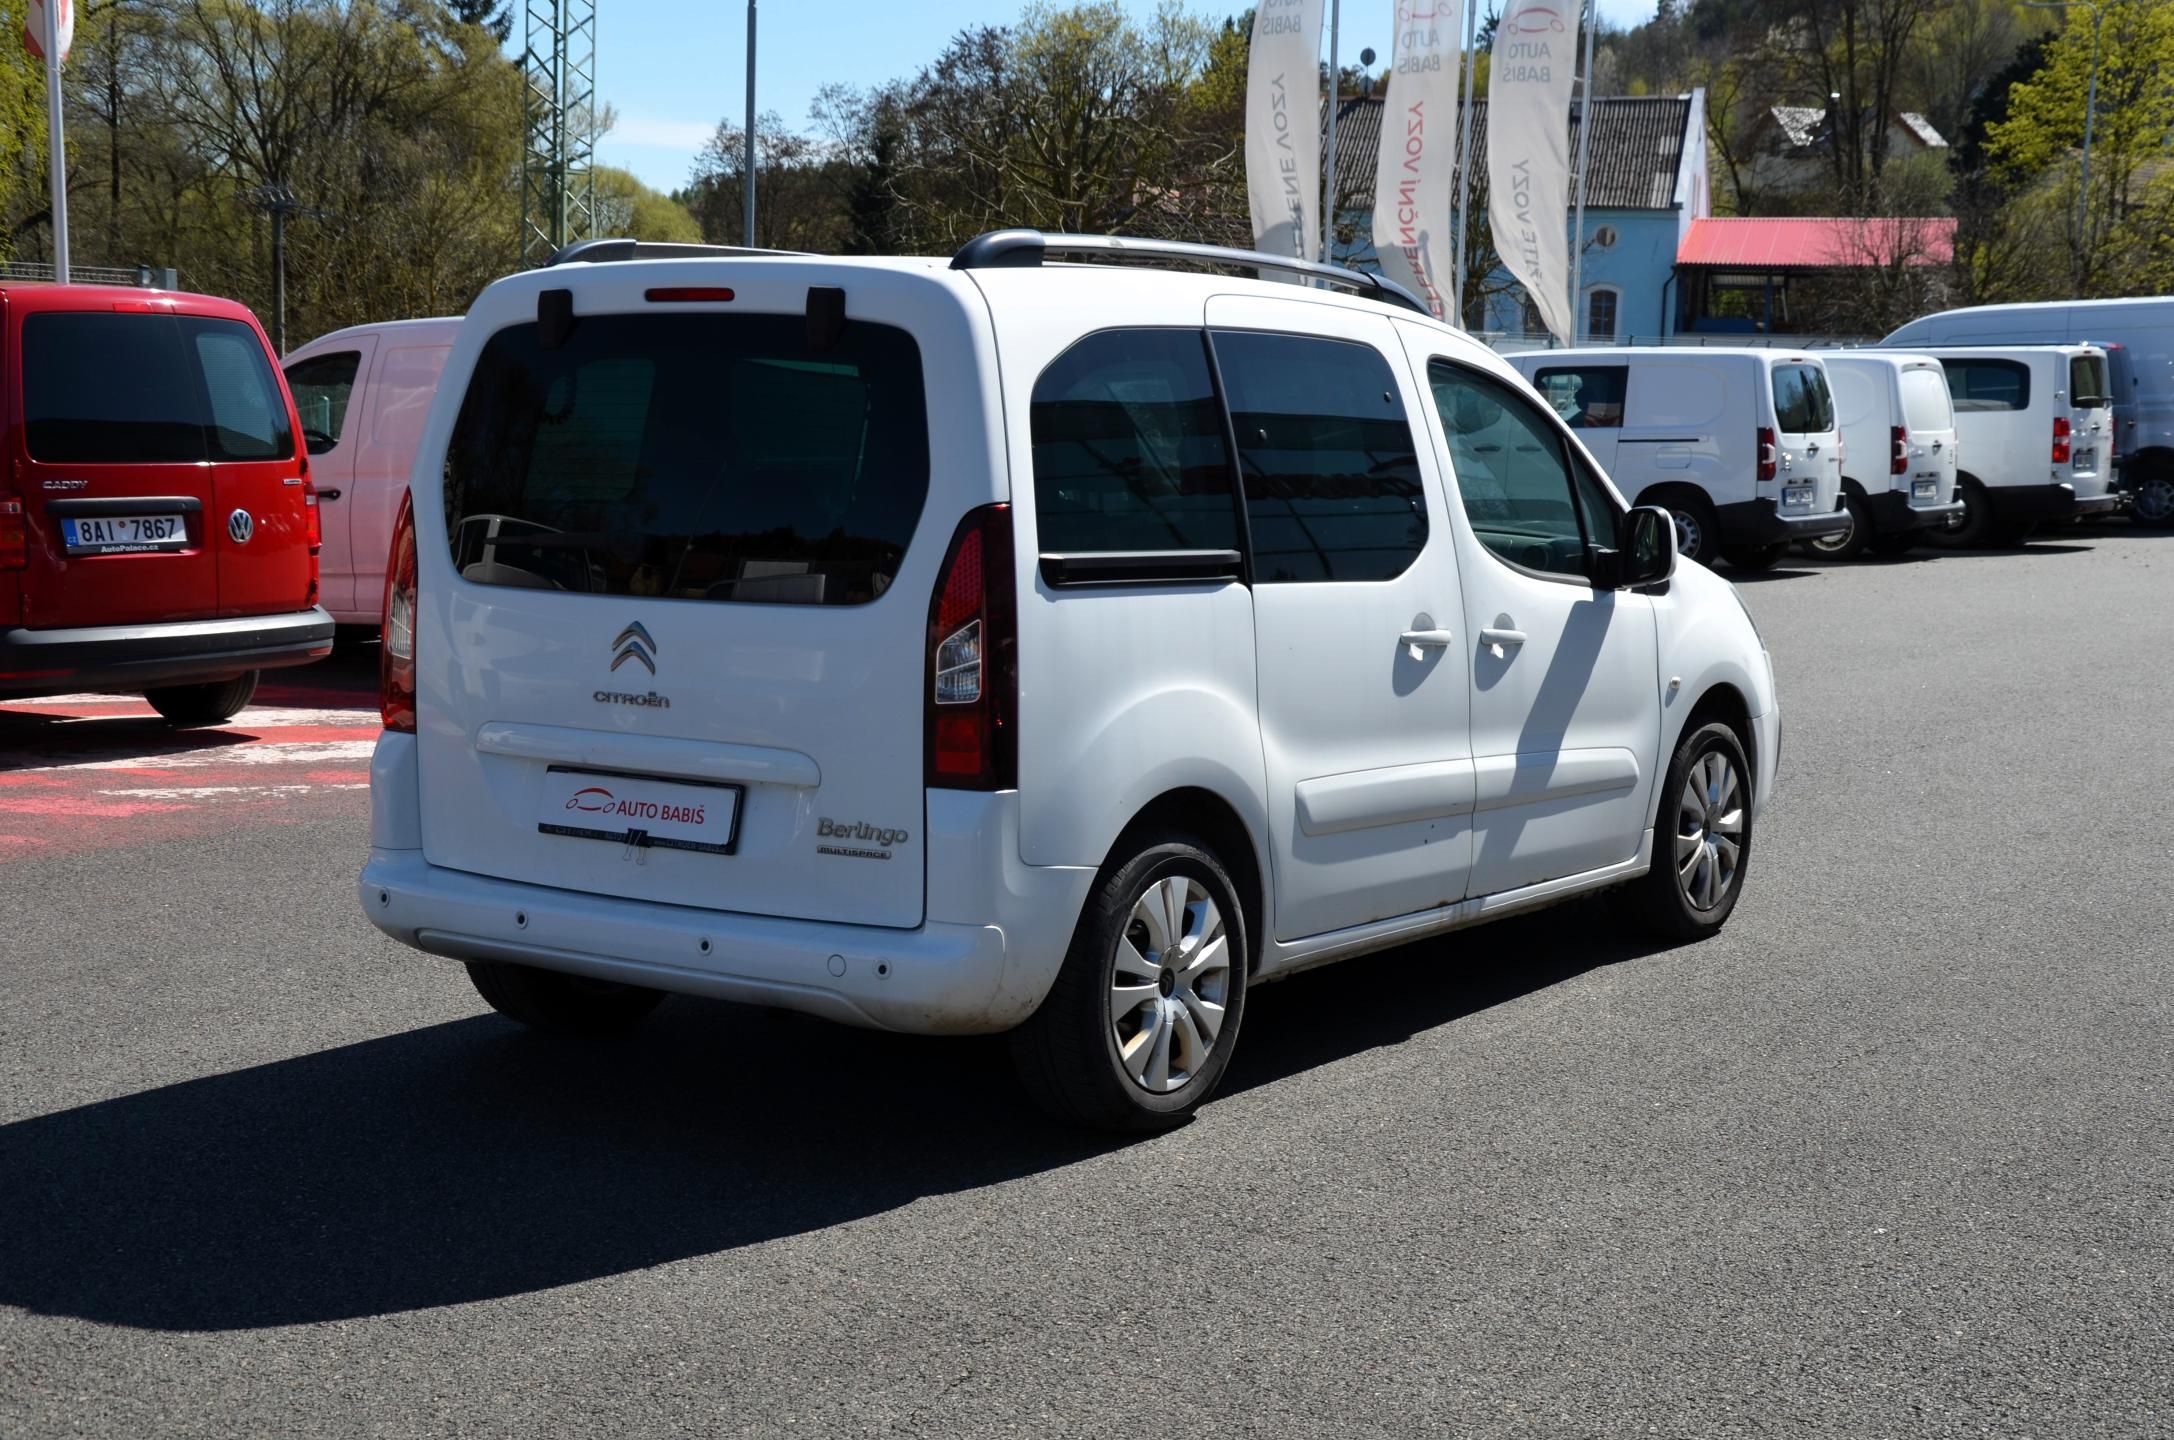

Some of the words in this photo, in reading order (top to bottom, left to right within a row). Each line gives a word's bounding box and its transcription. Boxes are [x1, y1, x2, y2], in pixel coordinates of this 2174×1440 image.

[43, 480, 88, 489] CADDY
[130, 518, 175, 540] 7867
[616, 800, 658, 819] AUTO
[660, 804, 705, 825] BABIŠ
[816, 817, 908, 847] Berlingo
[819, 847, 888, 859] MULTISPACE
